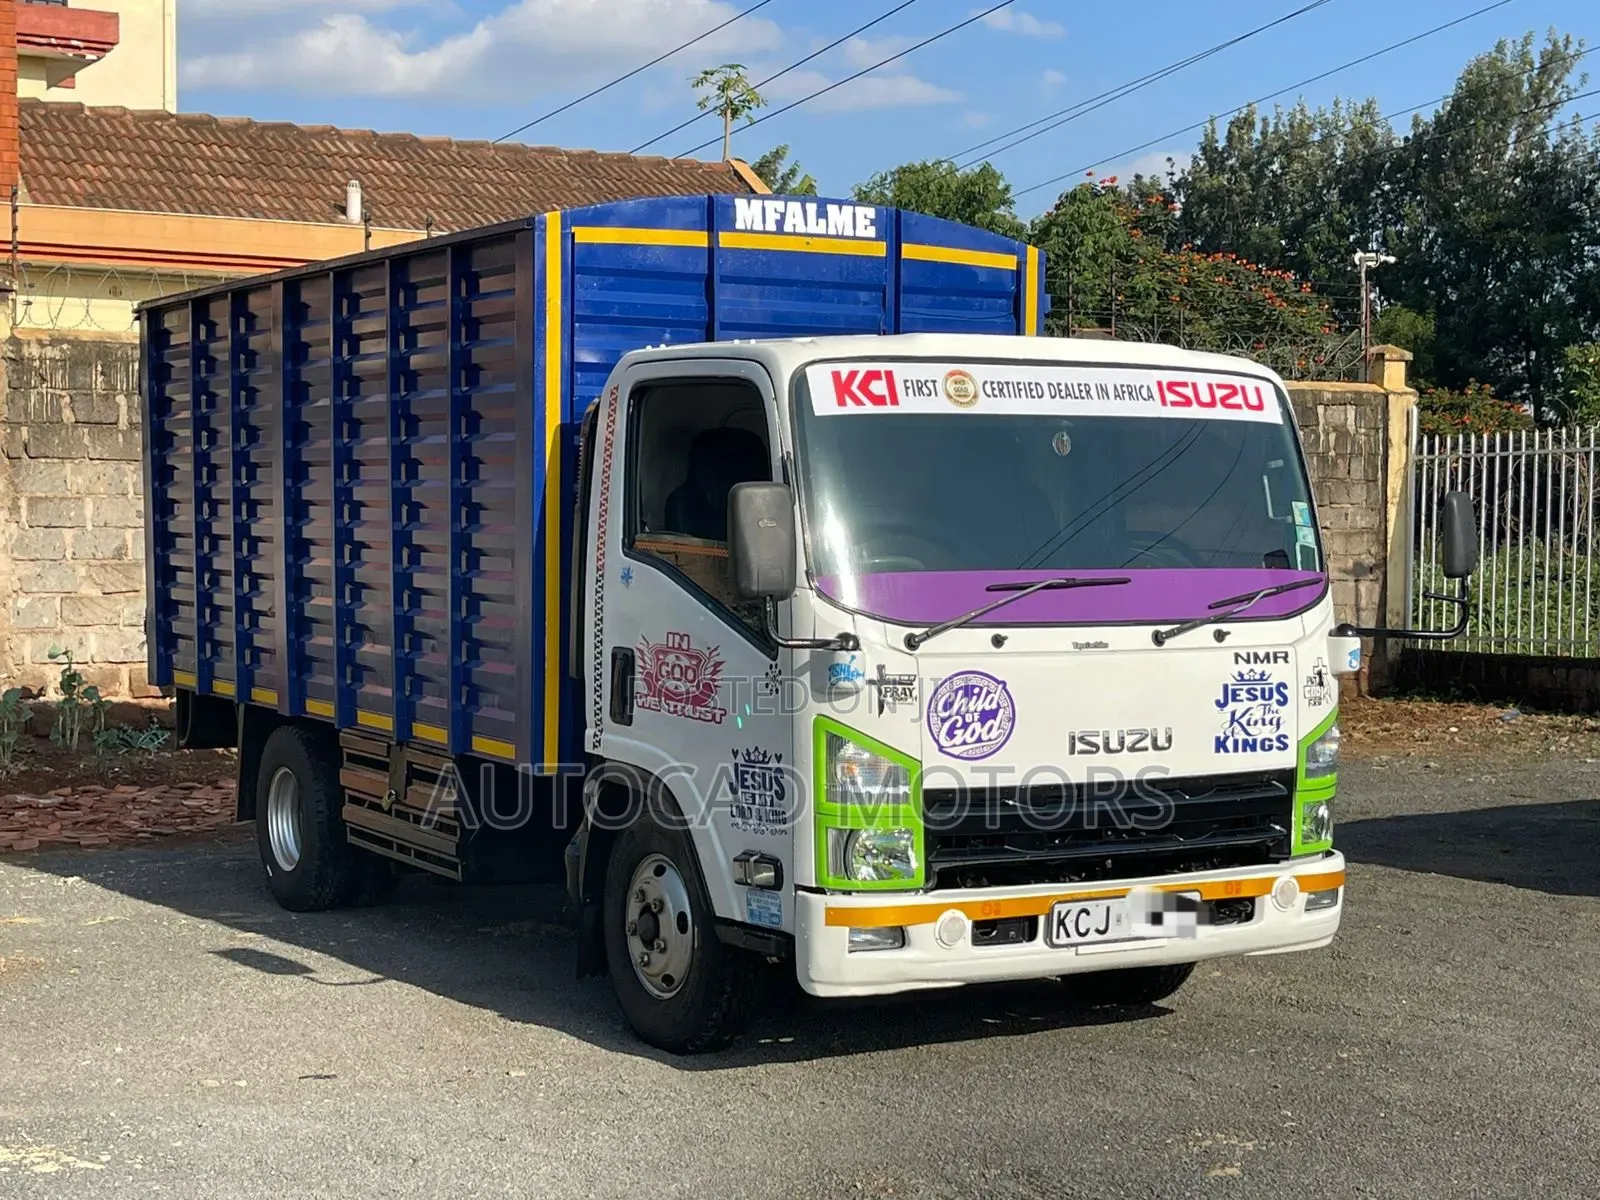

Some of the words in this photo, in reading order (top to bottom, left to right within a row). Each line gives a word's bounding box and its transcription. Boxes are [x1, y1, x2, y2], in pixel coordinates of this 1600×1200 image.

[734, 198, 876, 238] MFALME
[831, 370, 899, 407] KCI
[903, 379, 938, 397] FIRST
[982, 380, 1044, 399] CERTIFIED
[1048, 382, 1093, 400] DEALER
[1095, 383, 1110, 400] IN
[1113, 384, 1155, 402] AFRICA
[1156, 380, 1264, 411] ISUZU
[666, 632, 690, 650] IN
[658, 660, 697, 683] GOD
[1234, 651, 1290, 664] NMR
[883, 687, 915, 698] PRAY
[937, 684, 1003, 717] Child
[1214, 682, 1289, 708] JESUS
[636, 693, 661, 711] WE
[665, 700, 726, 723] TRUST
[965, 712, 980, 723] OF
[1221, 707, 1285, 737] King
[1257, 703, 1280, 717] The
[939, 709, 1004, 747] God
[1068, 727, 1172, 756] ISUZU
[1214, 734, 1289, 754] KINGS
[728, 763, 786, 800] JESUS
[1056, 906, 1110, 940] KCJ
